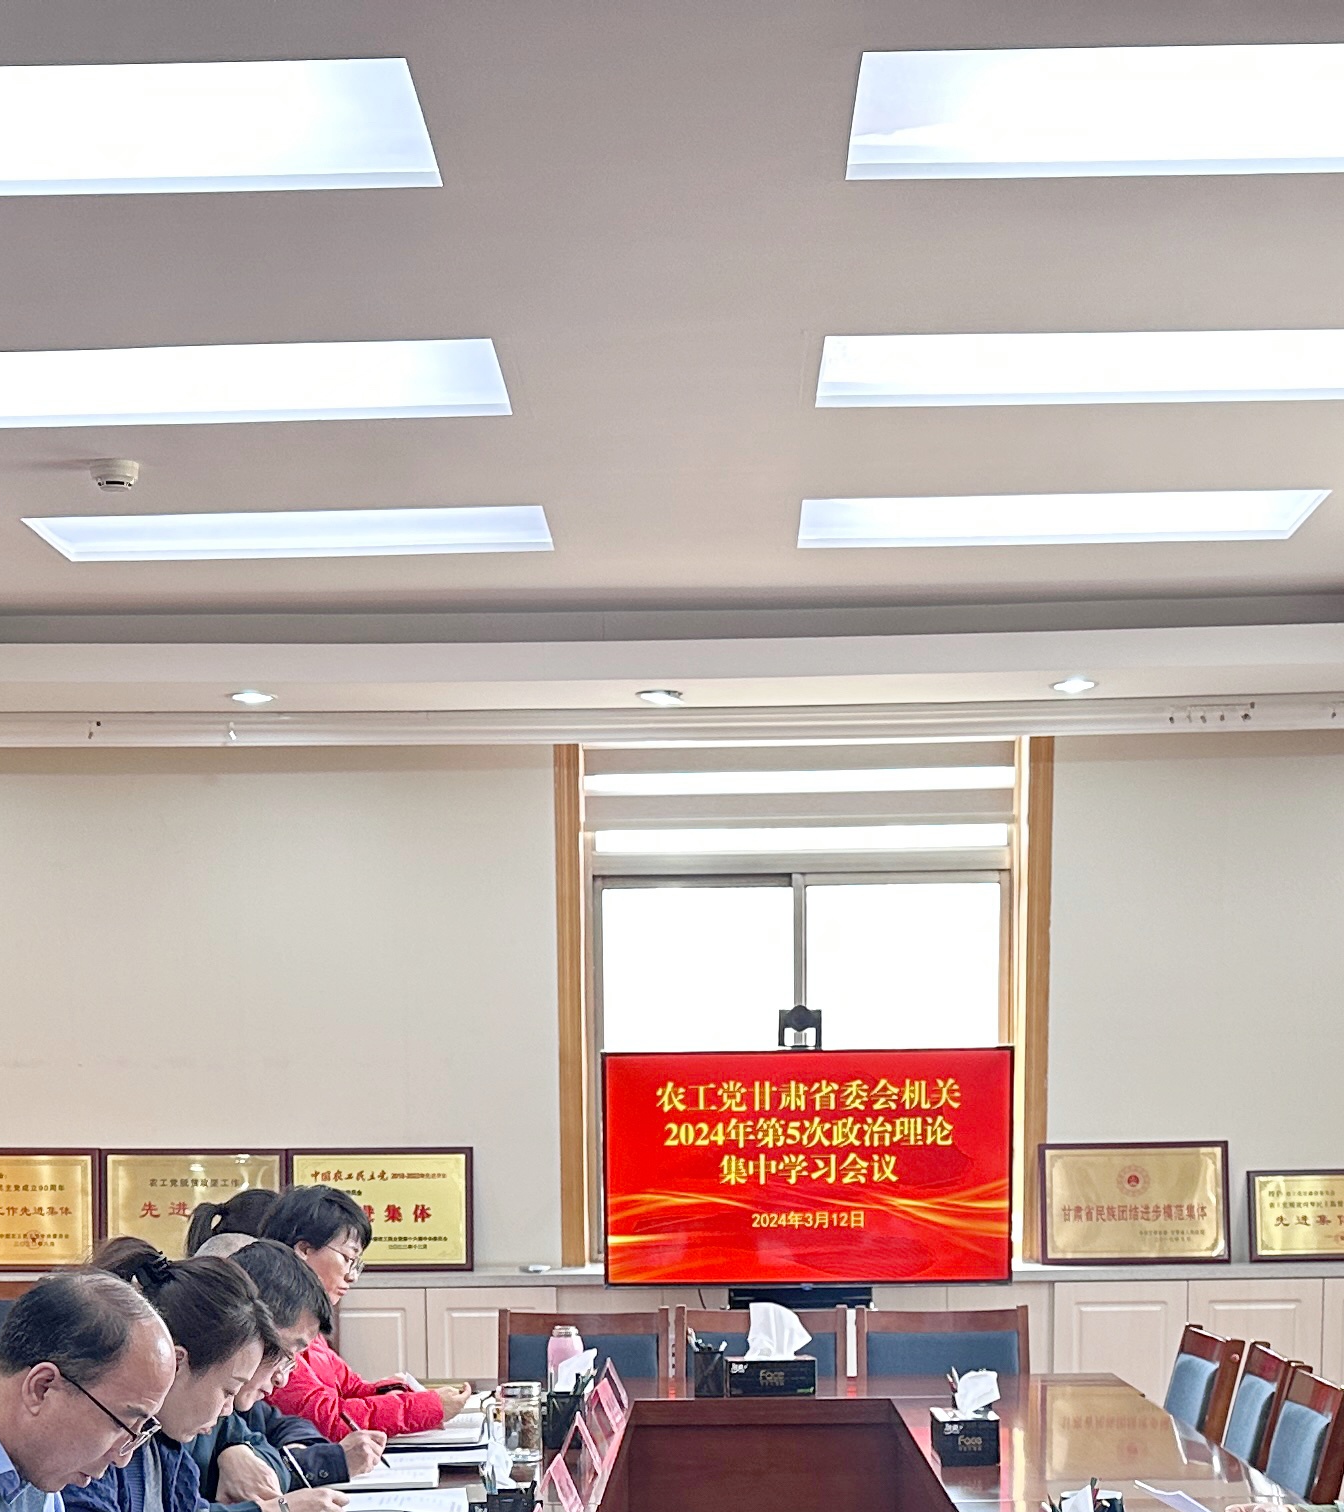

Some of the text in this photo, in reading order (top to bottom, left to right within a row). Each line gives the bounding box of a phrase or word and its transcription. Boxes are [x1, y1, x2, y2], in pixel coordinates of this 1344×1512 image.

[655, 1078, 962, 1112] 农工党甘肃省委会机关
[663, 1115, 954, 1148] 2024年第5次政治理论
[311, 1169, 389, 1182] 中国农工民主党
[719, 1153, 899, 1186] 集中学习会议
[139, 1201, 191, 1219] 先进
[751, 1210, 866, 1229] 2024年3月12日
[1062, 1203, 1207, 1223] 甘肃省民族团结进步模范集体
